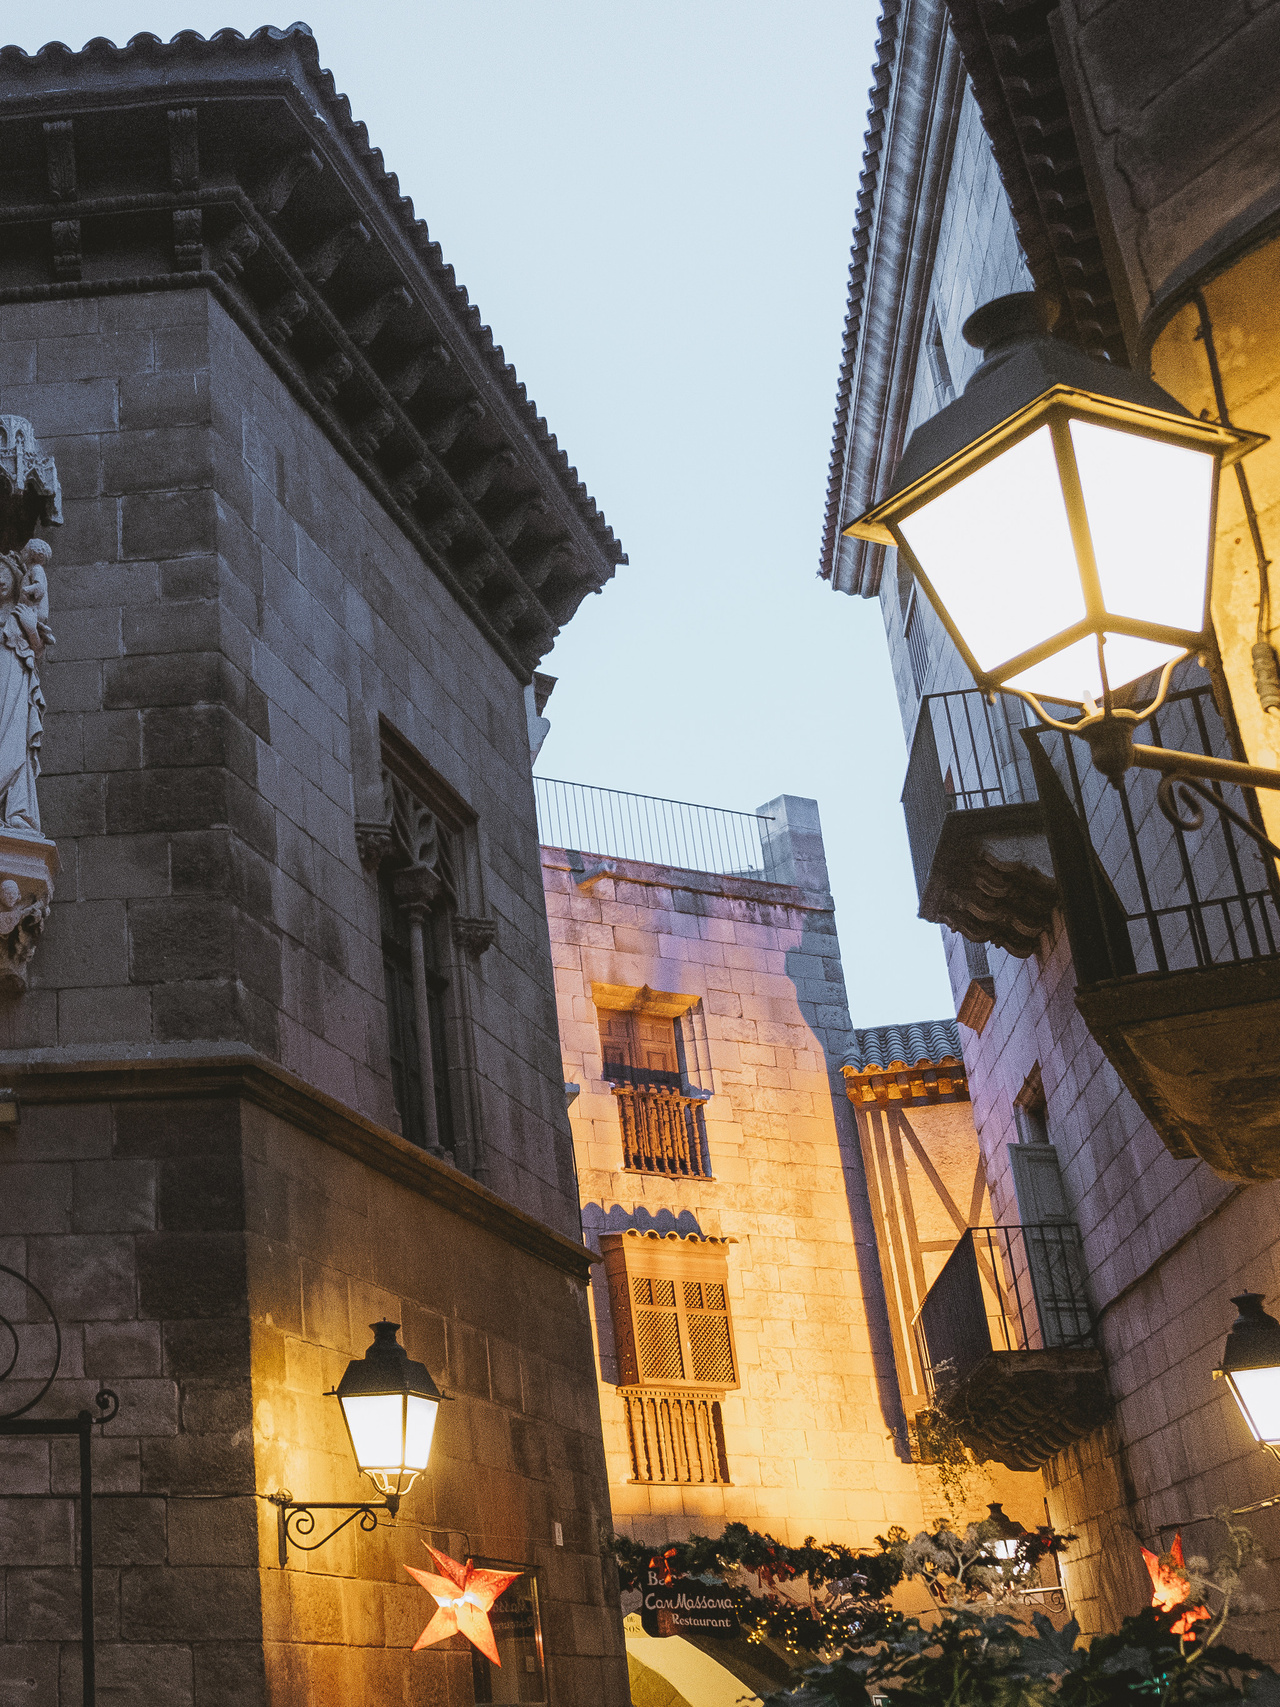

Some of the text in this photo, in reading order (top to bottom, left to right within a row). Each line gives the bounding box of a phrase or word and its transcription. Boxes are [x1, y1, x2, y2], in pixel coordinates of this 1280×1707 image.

[645, 1593, 734, 1610] Can Massana
[671, 1613, 731, 1627] Restaurant
